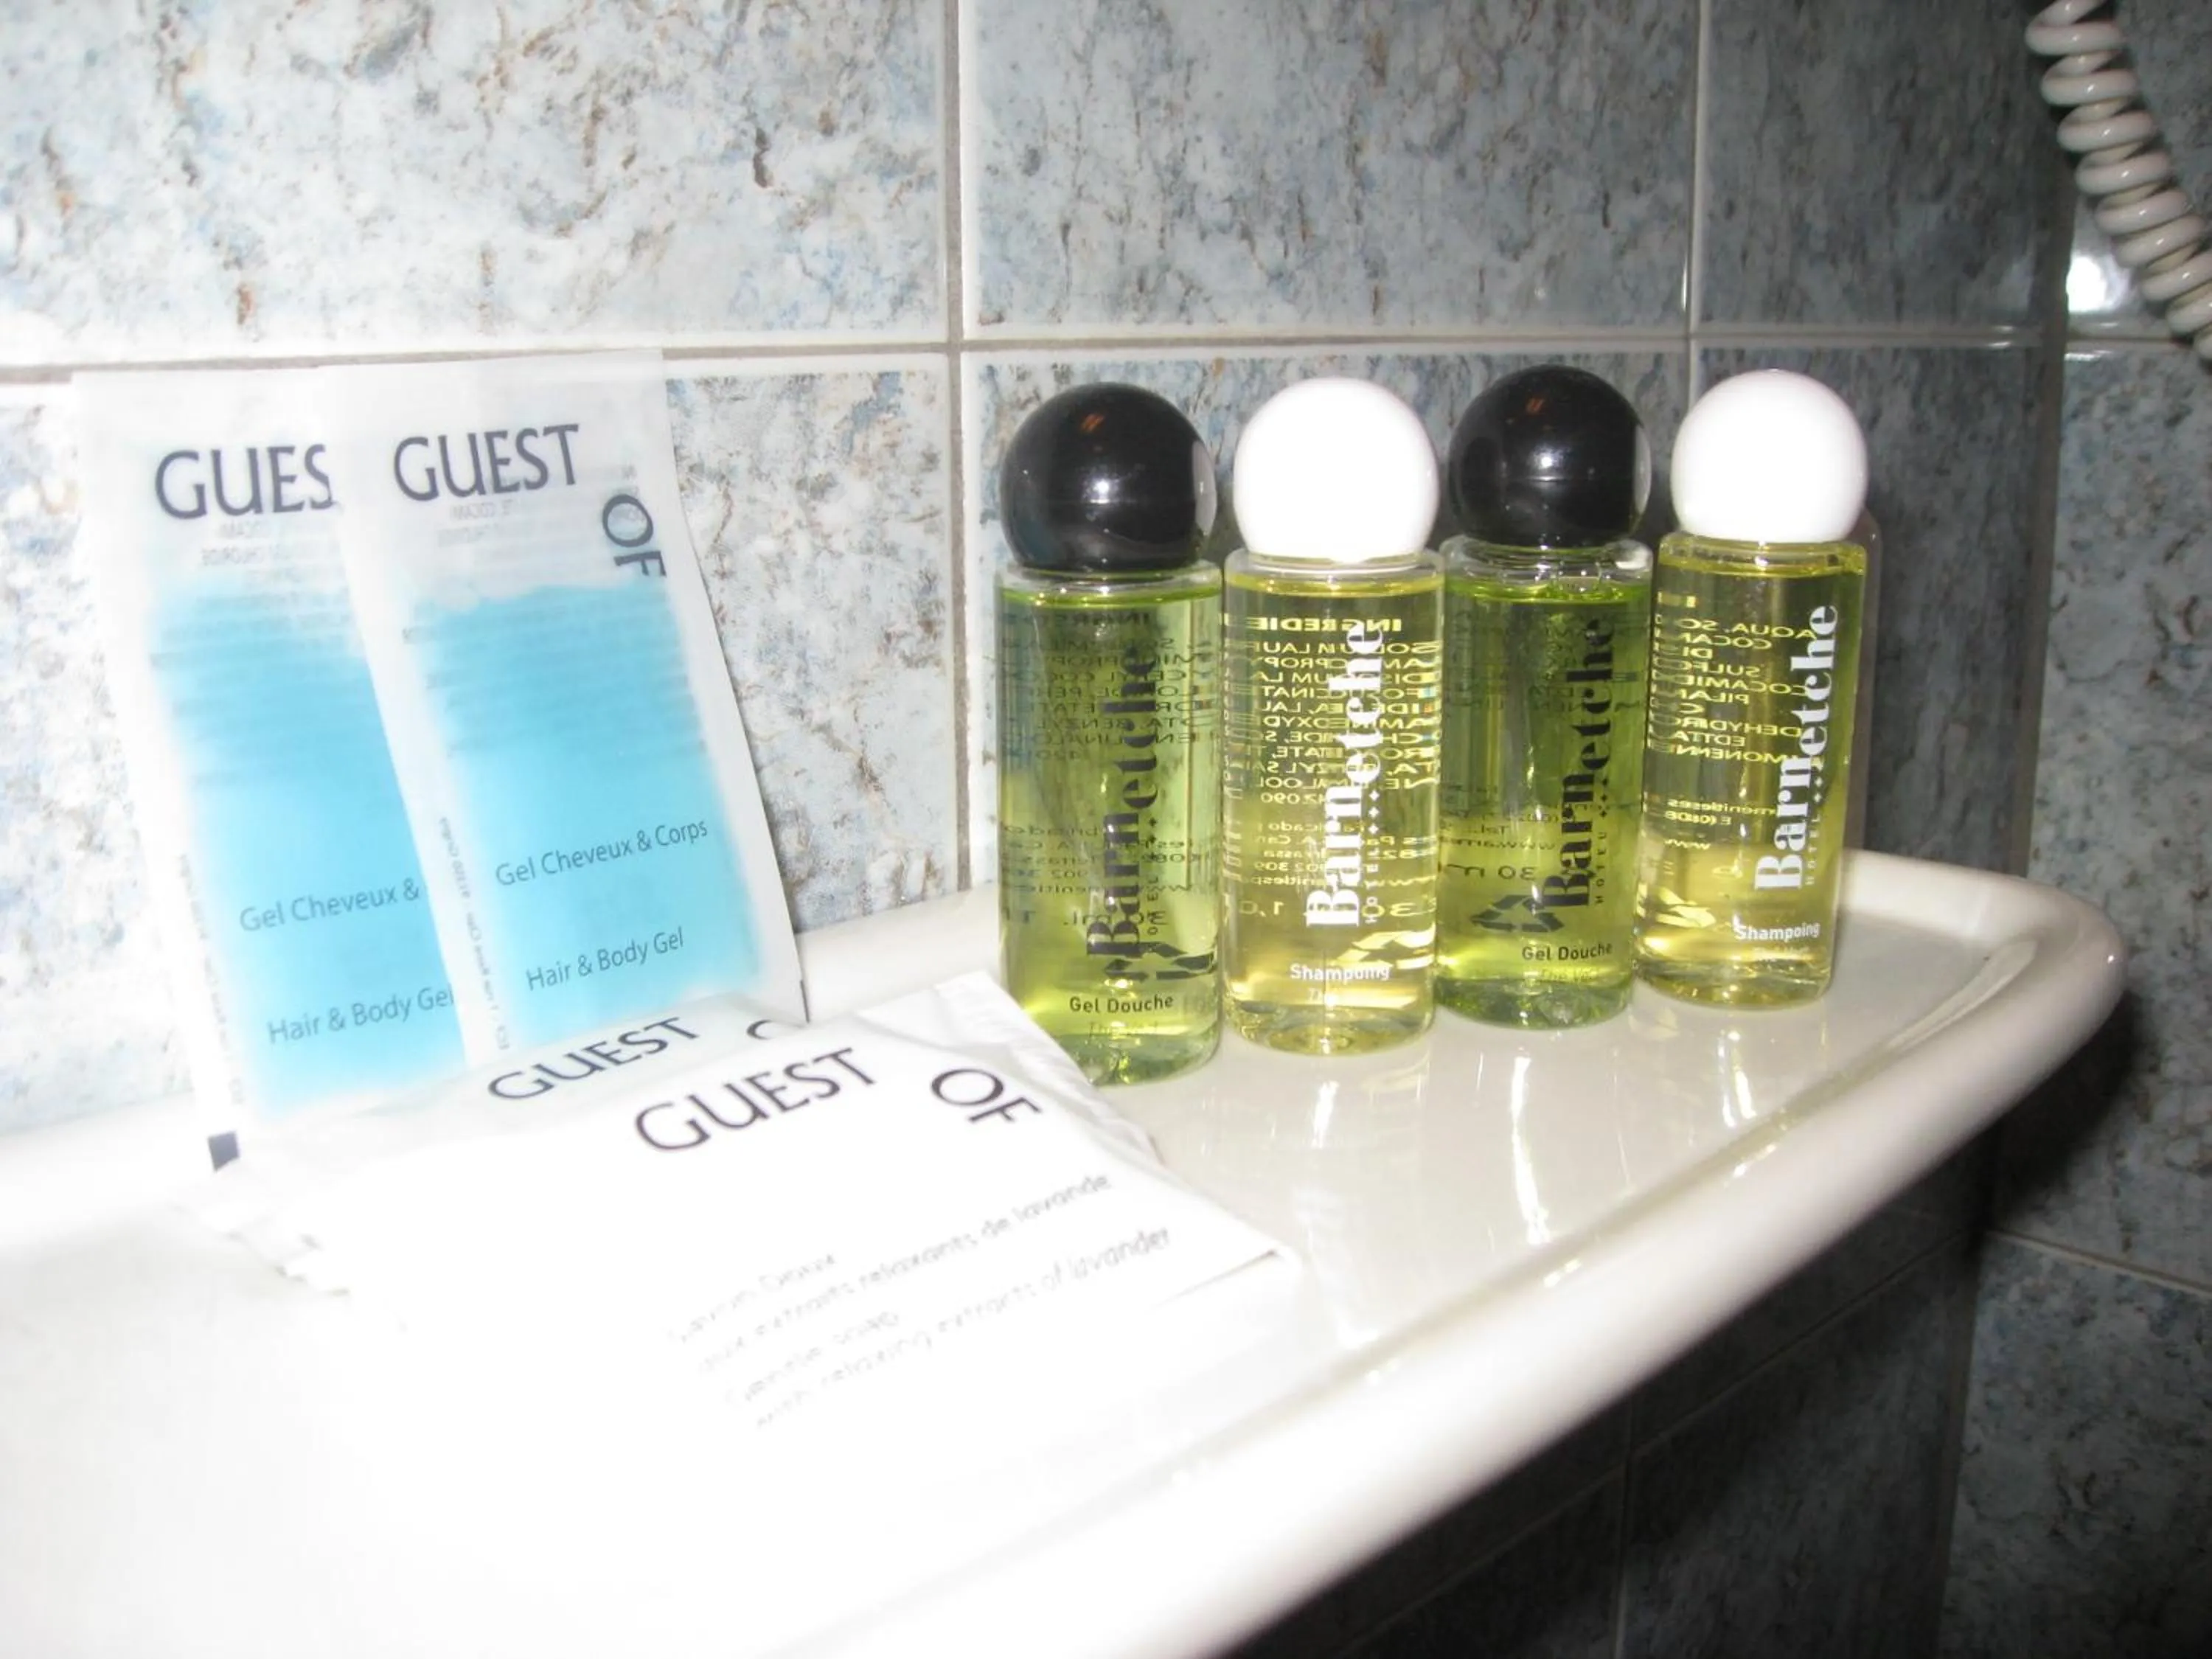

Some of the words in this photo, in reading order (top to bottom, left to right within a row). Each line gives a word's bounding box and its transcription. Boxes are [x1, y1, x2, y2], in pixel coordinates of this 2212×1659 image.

[393, 424, 580, 502] GUEST
[602, 493, 667, 577] OF
[1306, 619, 1383, 928] Barnetche
[1542, 618, 1615, 907] Barnetche
[1754, 605, 1838, 890] Barnetche
[495, 857, 536, 886] Gel
[540, 838, 633, 874] Cheveux
[636, 830, 653, 852] &
[655, 820, 709, 847] Corps
[239, 901, 286, 931] Gel
[291, 884, 398, 922] Cheveux
[403, 877, 420, 902] &
[1735, 923, 1821, 942] Shampoing
[526, 961, 572, 991] Hair
[577, 954, 594, 978] &
[597, 939, 649, 973] Body
[653, 925, 684, 954] Gel
[1522, 946, 1551, 961] Gel
[1558, 943, 1613, 961] Douche
[267, 1012, 320, 1045] Hair
[327, 1006, 347, 1032] &
[352, 993, 412, 1027] Body
[1069, 996, 1099, 1014] Gel
[1107, 994, 1175, 1014] Douche
[487, 1017, 700, 1101] GUEST
[635, 1047, 877, 1152] GUEST
[931, 1068, 1044, 1124] OF
[858, 1232, 979, 1291] relaxants
[981, 1218, 1011, 1239] de
[1011, 1175, 1113, 1223] lavande
[1067, 1225, 1171, 1281] lavander
